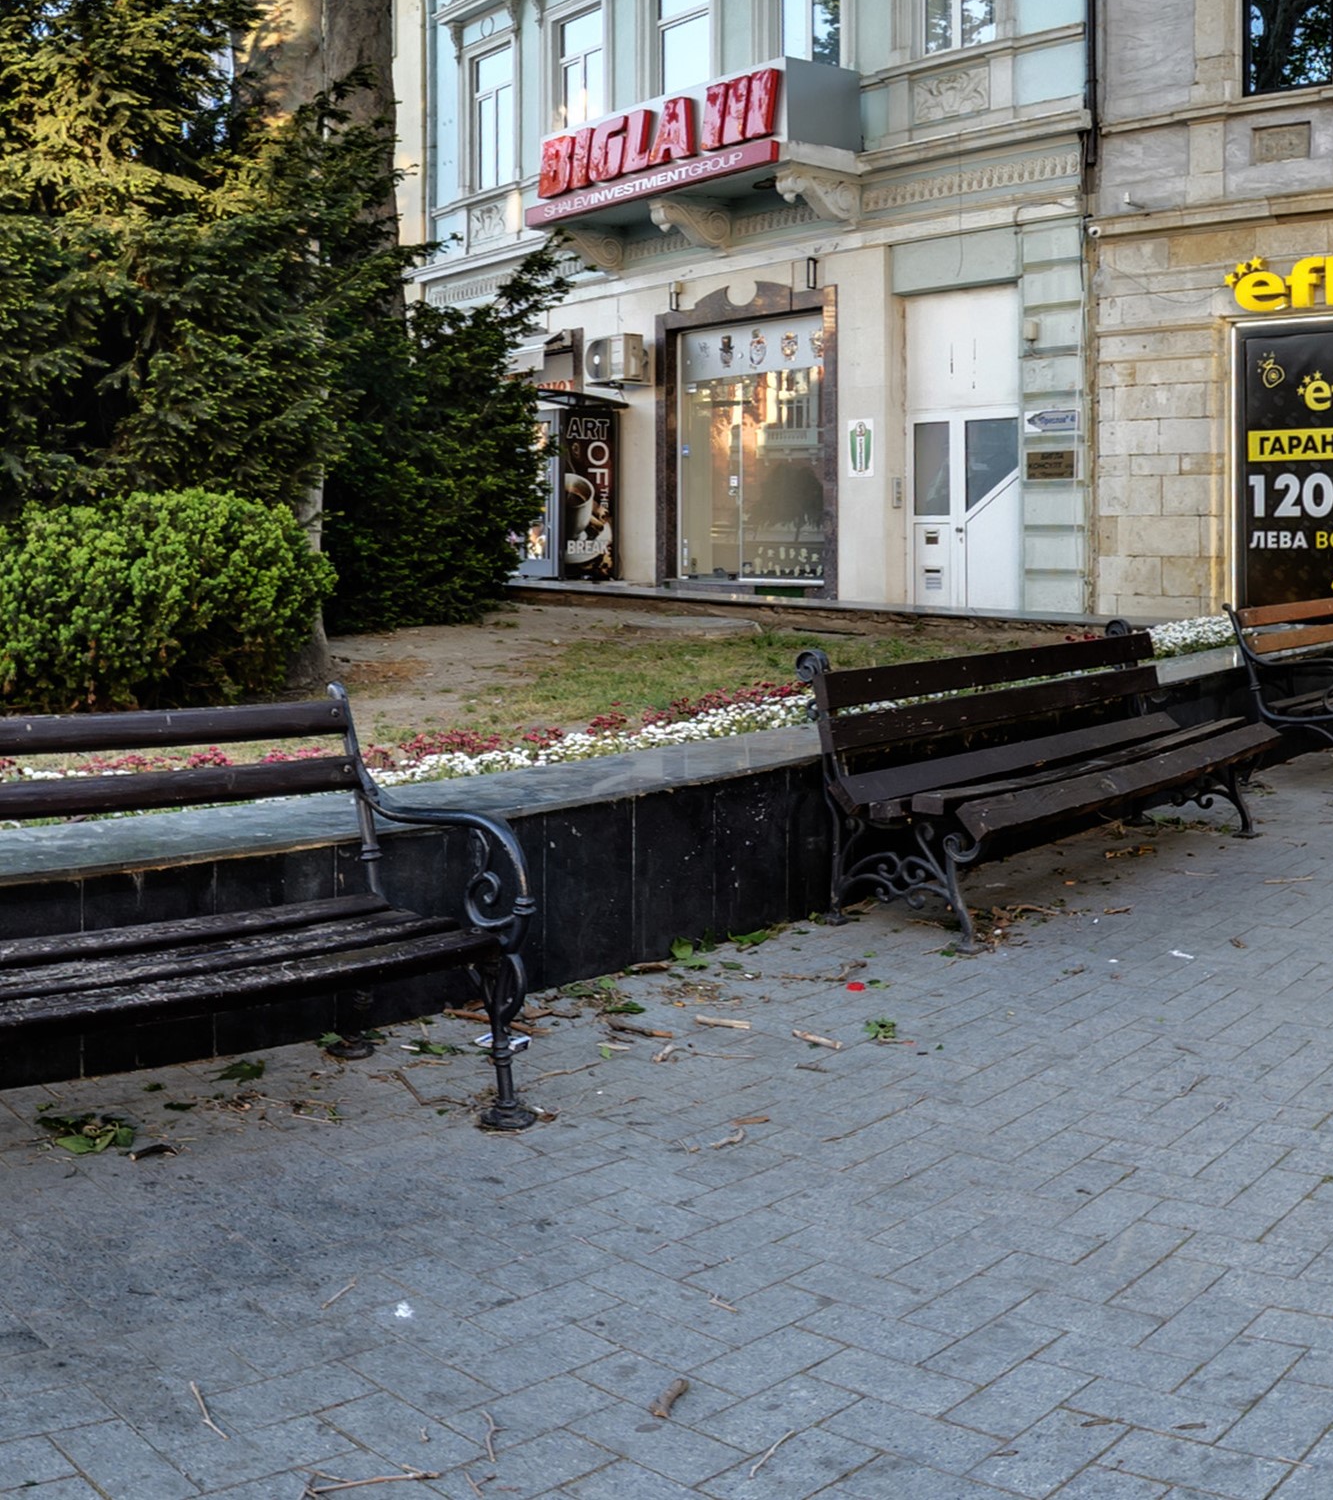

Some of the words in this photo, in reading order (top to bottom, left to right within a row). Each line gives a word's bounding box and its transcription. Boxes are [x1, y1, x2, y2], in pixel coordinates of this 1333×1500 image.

[538, 97, 697, 199] BIGLA
[567, 418, 610, 439] ART
[587, 441, 609, 485] OF
[567, 540, 609, 555] BREAK
[1249, 531, 1308, 549] ЛЕВА
